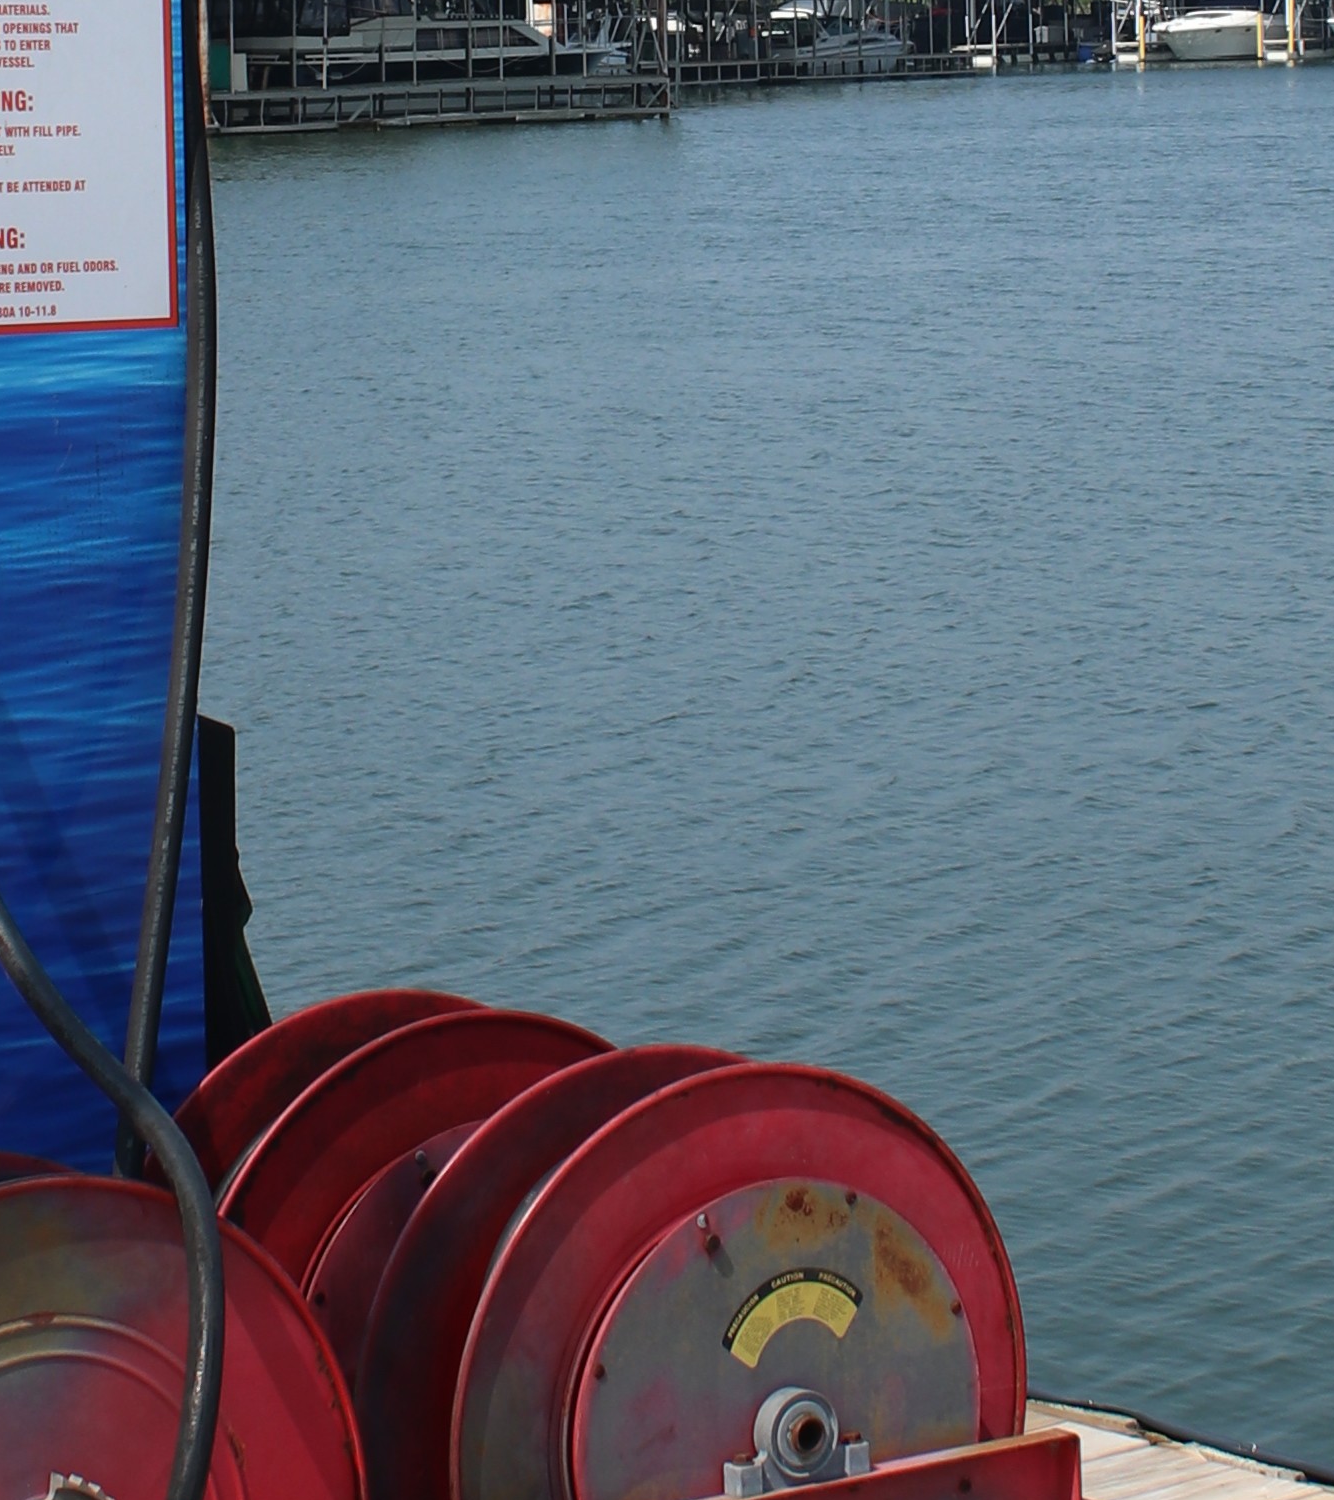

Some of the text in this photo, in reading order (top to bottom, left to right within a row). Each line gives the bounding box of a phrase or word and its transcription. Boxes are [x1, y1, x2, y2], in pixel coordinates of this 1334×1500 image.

[2, 22, 52, 34] OPENINGS
[54, 22, 78, 33] THAT
[3, 39, 16, 51] TO
[19, 39, 50, 50] ENTER
[4, 126, 30, 137] WITH
[33, 125, 53, 137] FILL
[56, 125, 81, 136] PIPE.
[6, 181, 19, 193] BE
[22, 180, 71, 192] ATTENDED
[74, 179, 85, 190] AT
[17, 262, 37, 274] AND
[40, 262, 54, 273] OR
[56, 261, 81, 273] FUEL
[82, 259, 118, 272] ODORS.
[14, 280, 66, 293] REMOVED.
[770, 1271, 805, 1289] CAUTION
